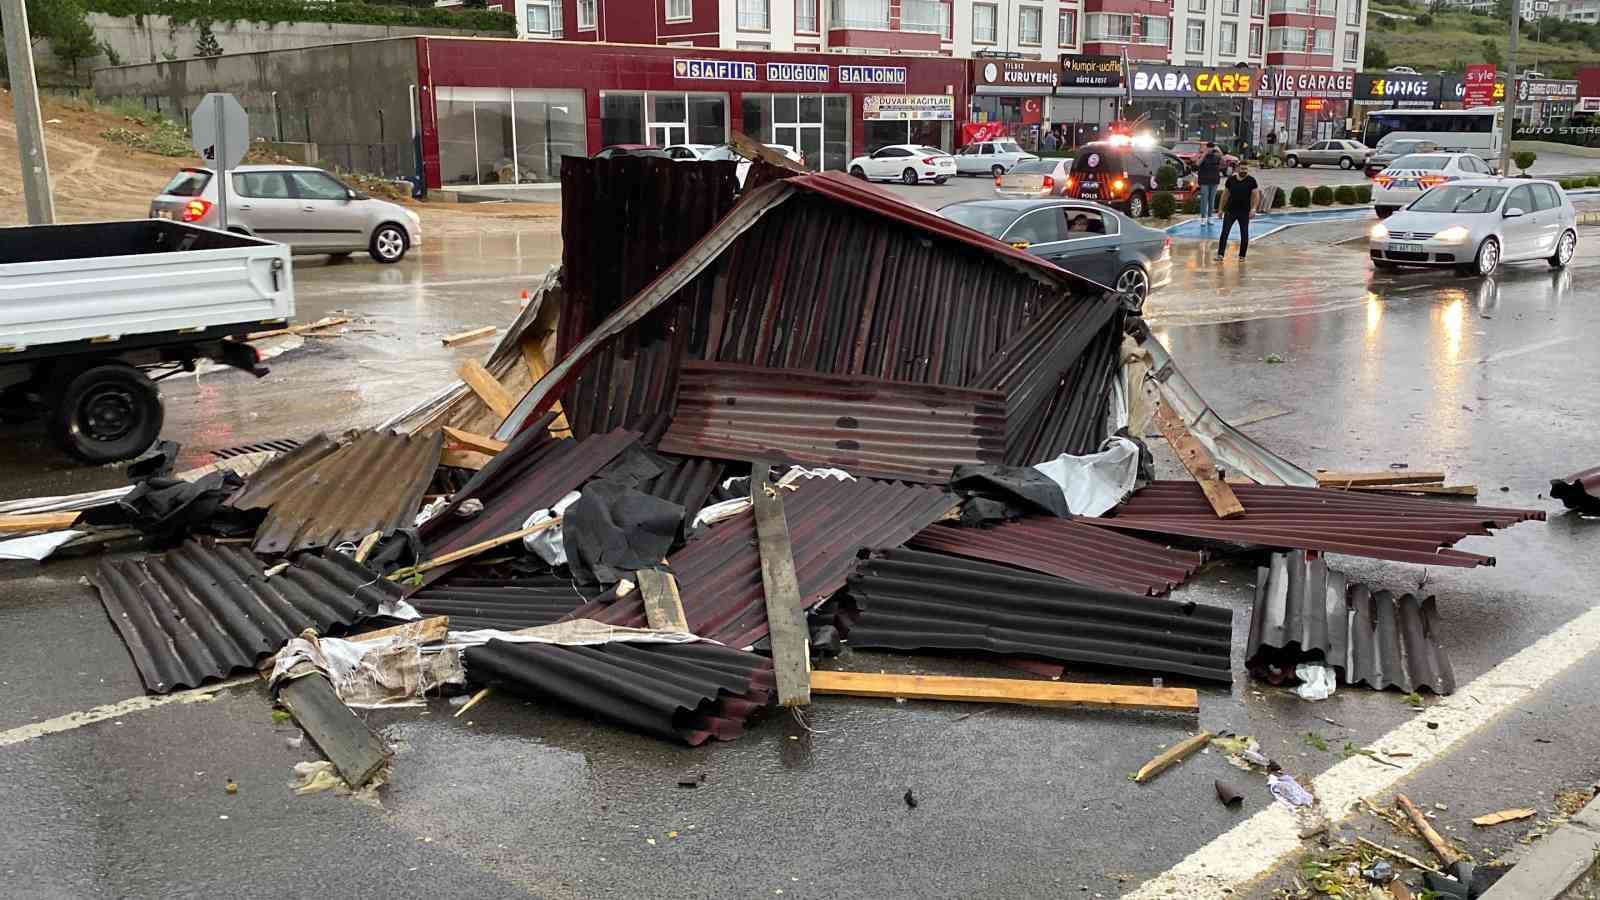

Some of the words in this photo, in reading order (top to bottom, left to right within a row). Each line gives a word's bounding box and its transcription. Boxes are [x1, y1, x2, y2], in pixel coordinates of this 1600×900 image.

[770, 65, 827, 80] DÜĞÜN
[841, 69, 904, 82] SALONU
[1004, 69, 1057, 85] KURUYEMİŞ
[1298, 74, 1353, 89] GARAGE
[1134, 72, 1192, 91] BABA
[1196, 72, 1250, 92] CAR'S
[1385, 79, 1429, 96] GARAGE
[879, 97, 907, 105] DUVAR
